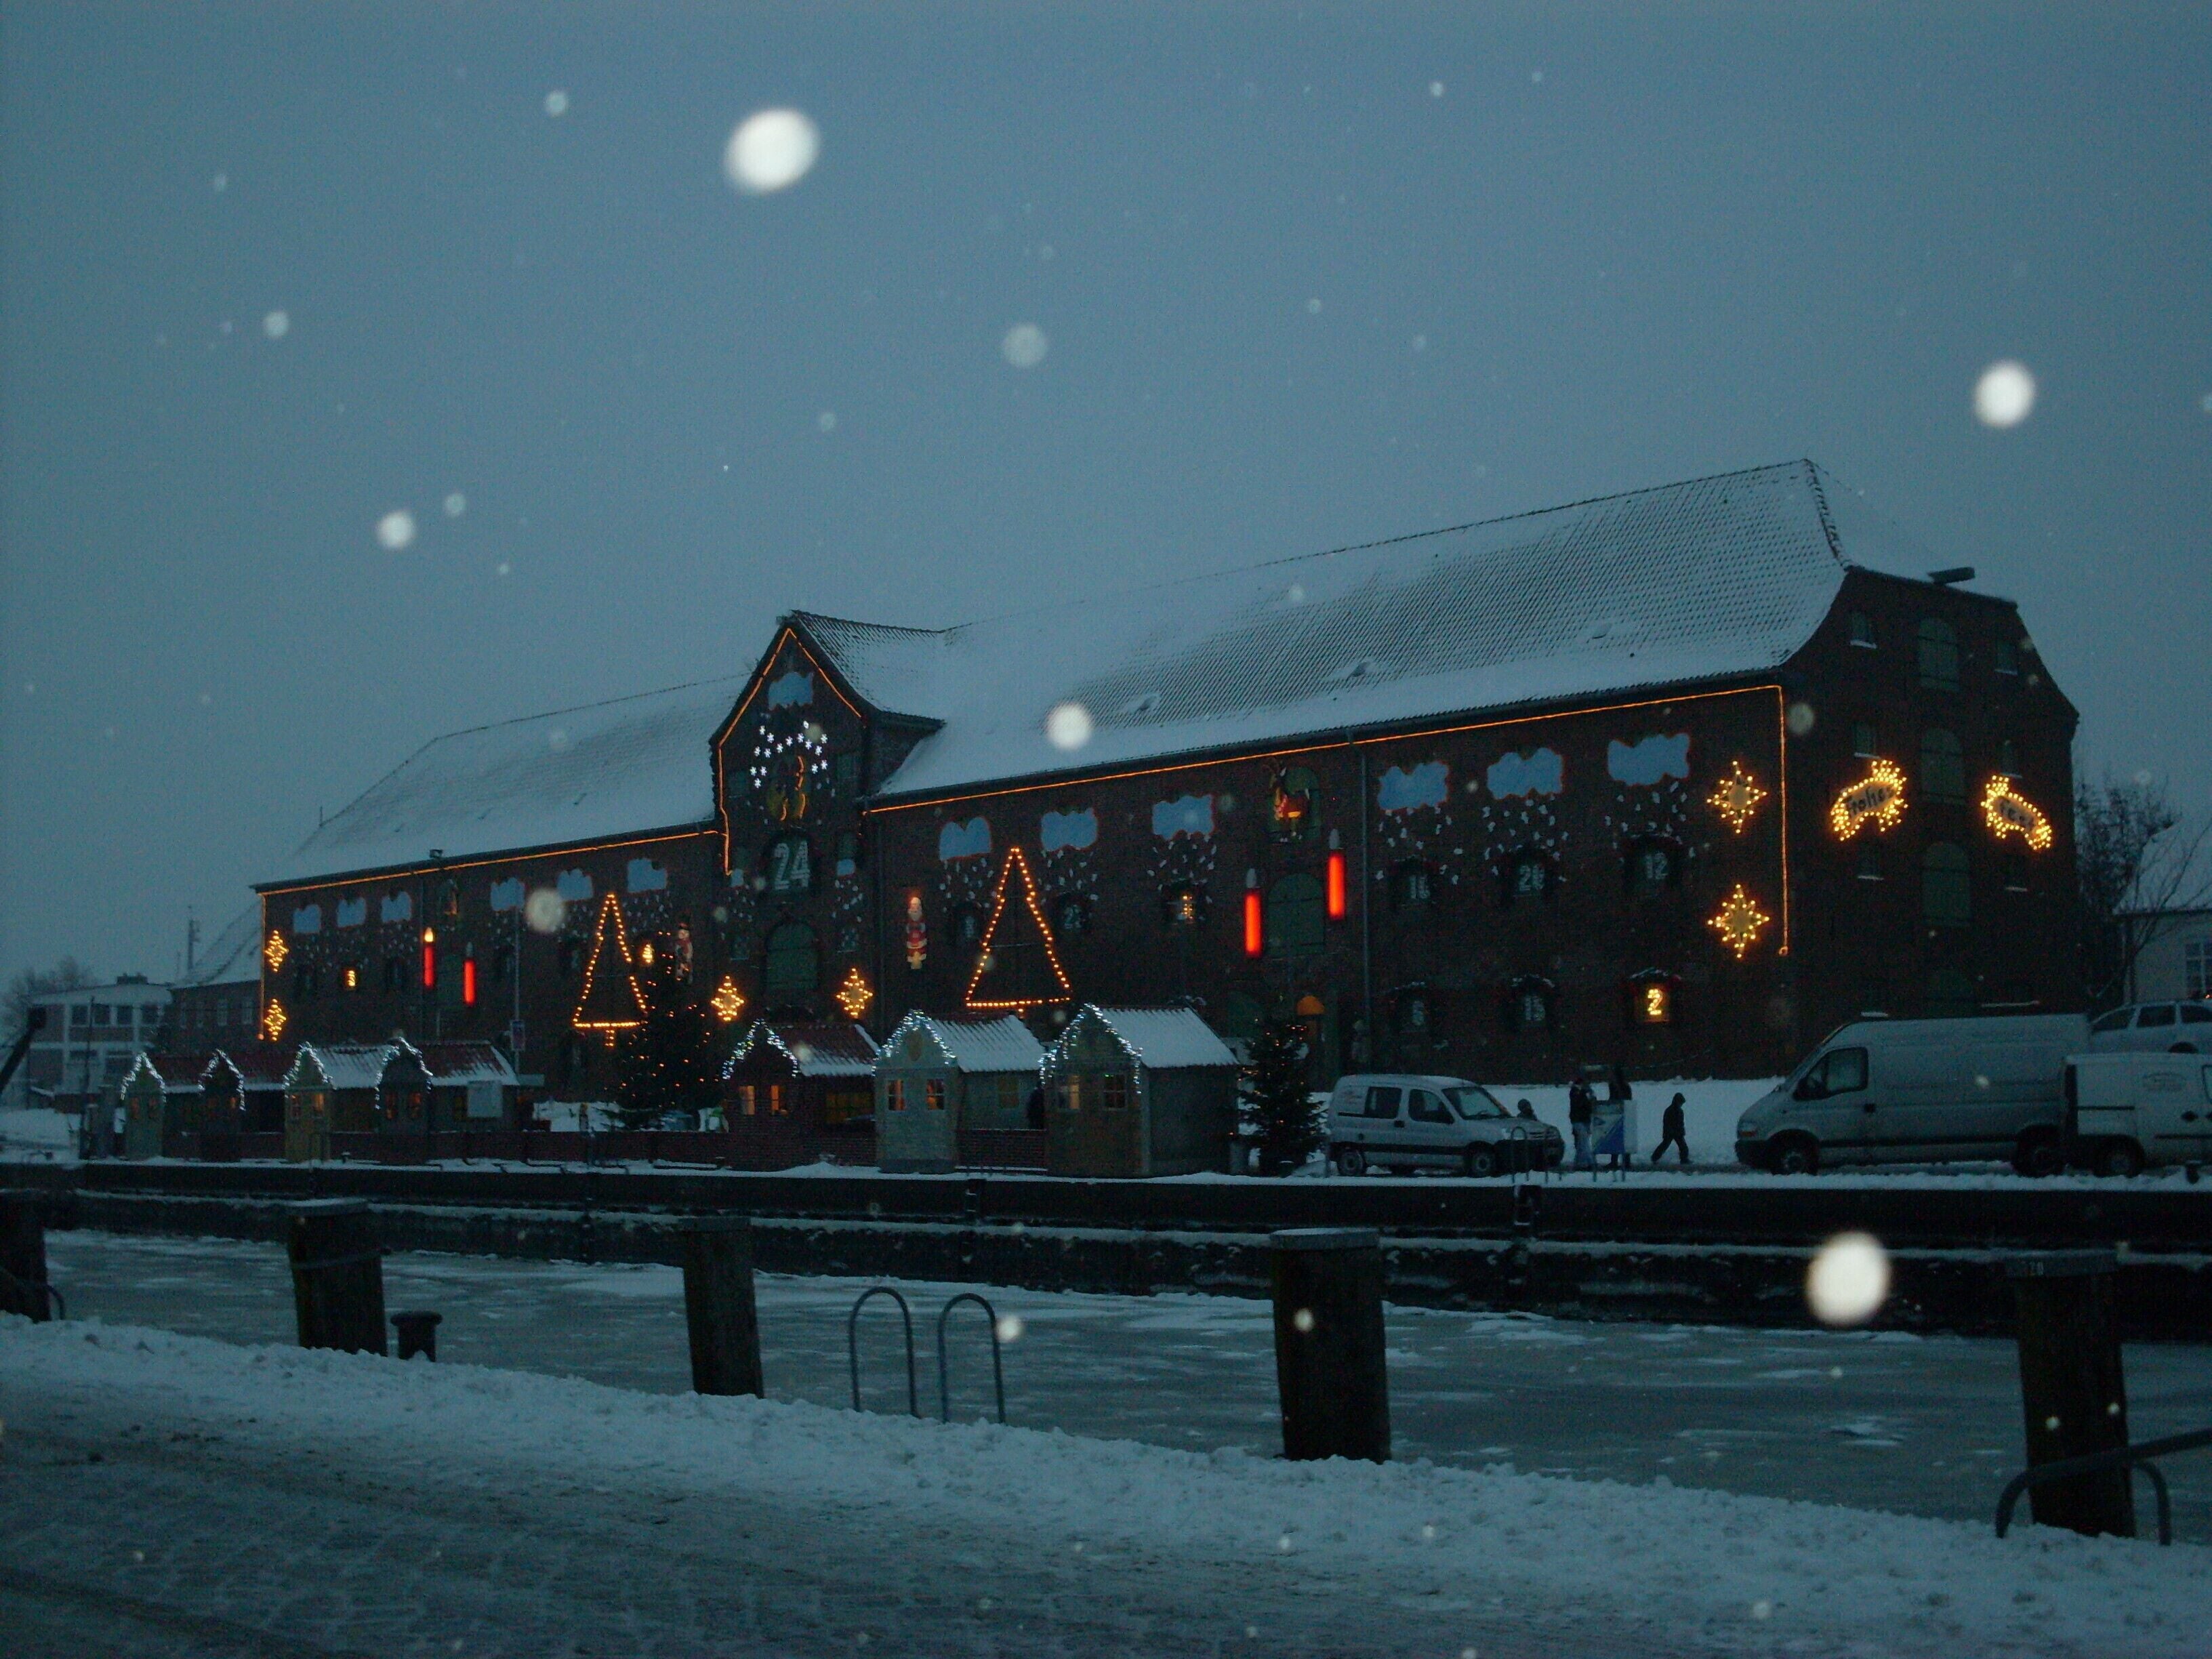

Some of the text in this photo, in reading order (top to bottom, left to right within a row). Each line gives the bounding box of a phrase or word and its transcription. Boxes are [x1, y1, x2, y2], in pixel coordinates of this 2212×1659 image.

[774, 840, 811, 889] 24
[1645, 852, 1668, 880] 12
[1647, 988, 1663, 1016] 2
